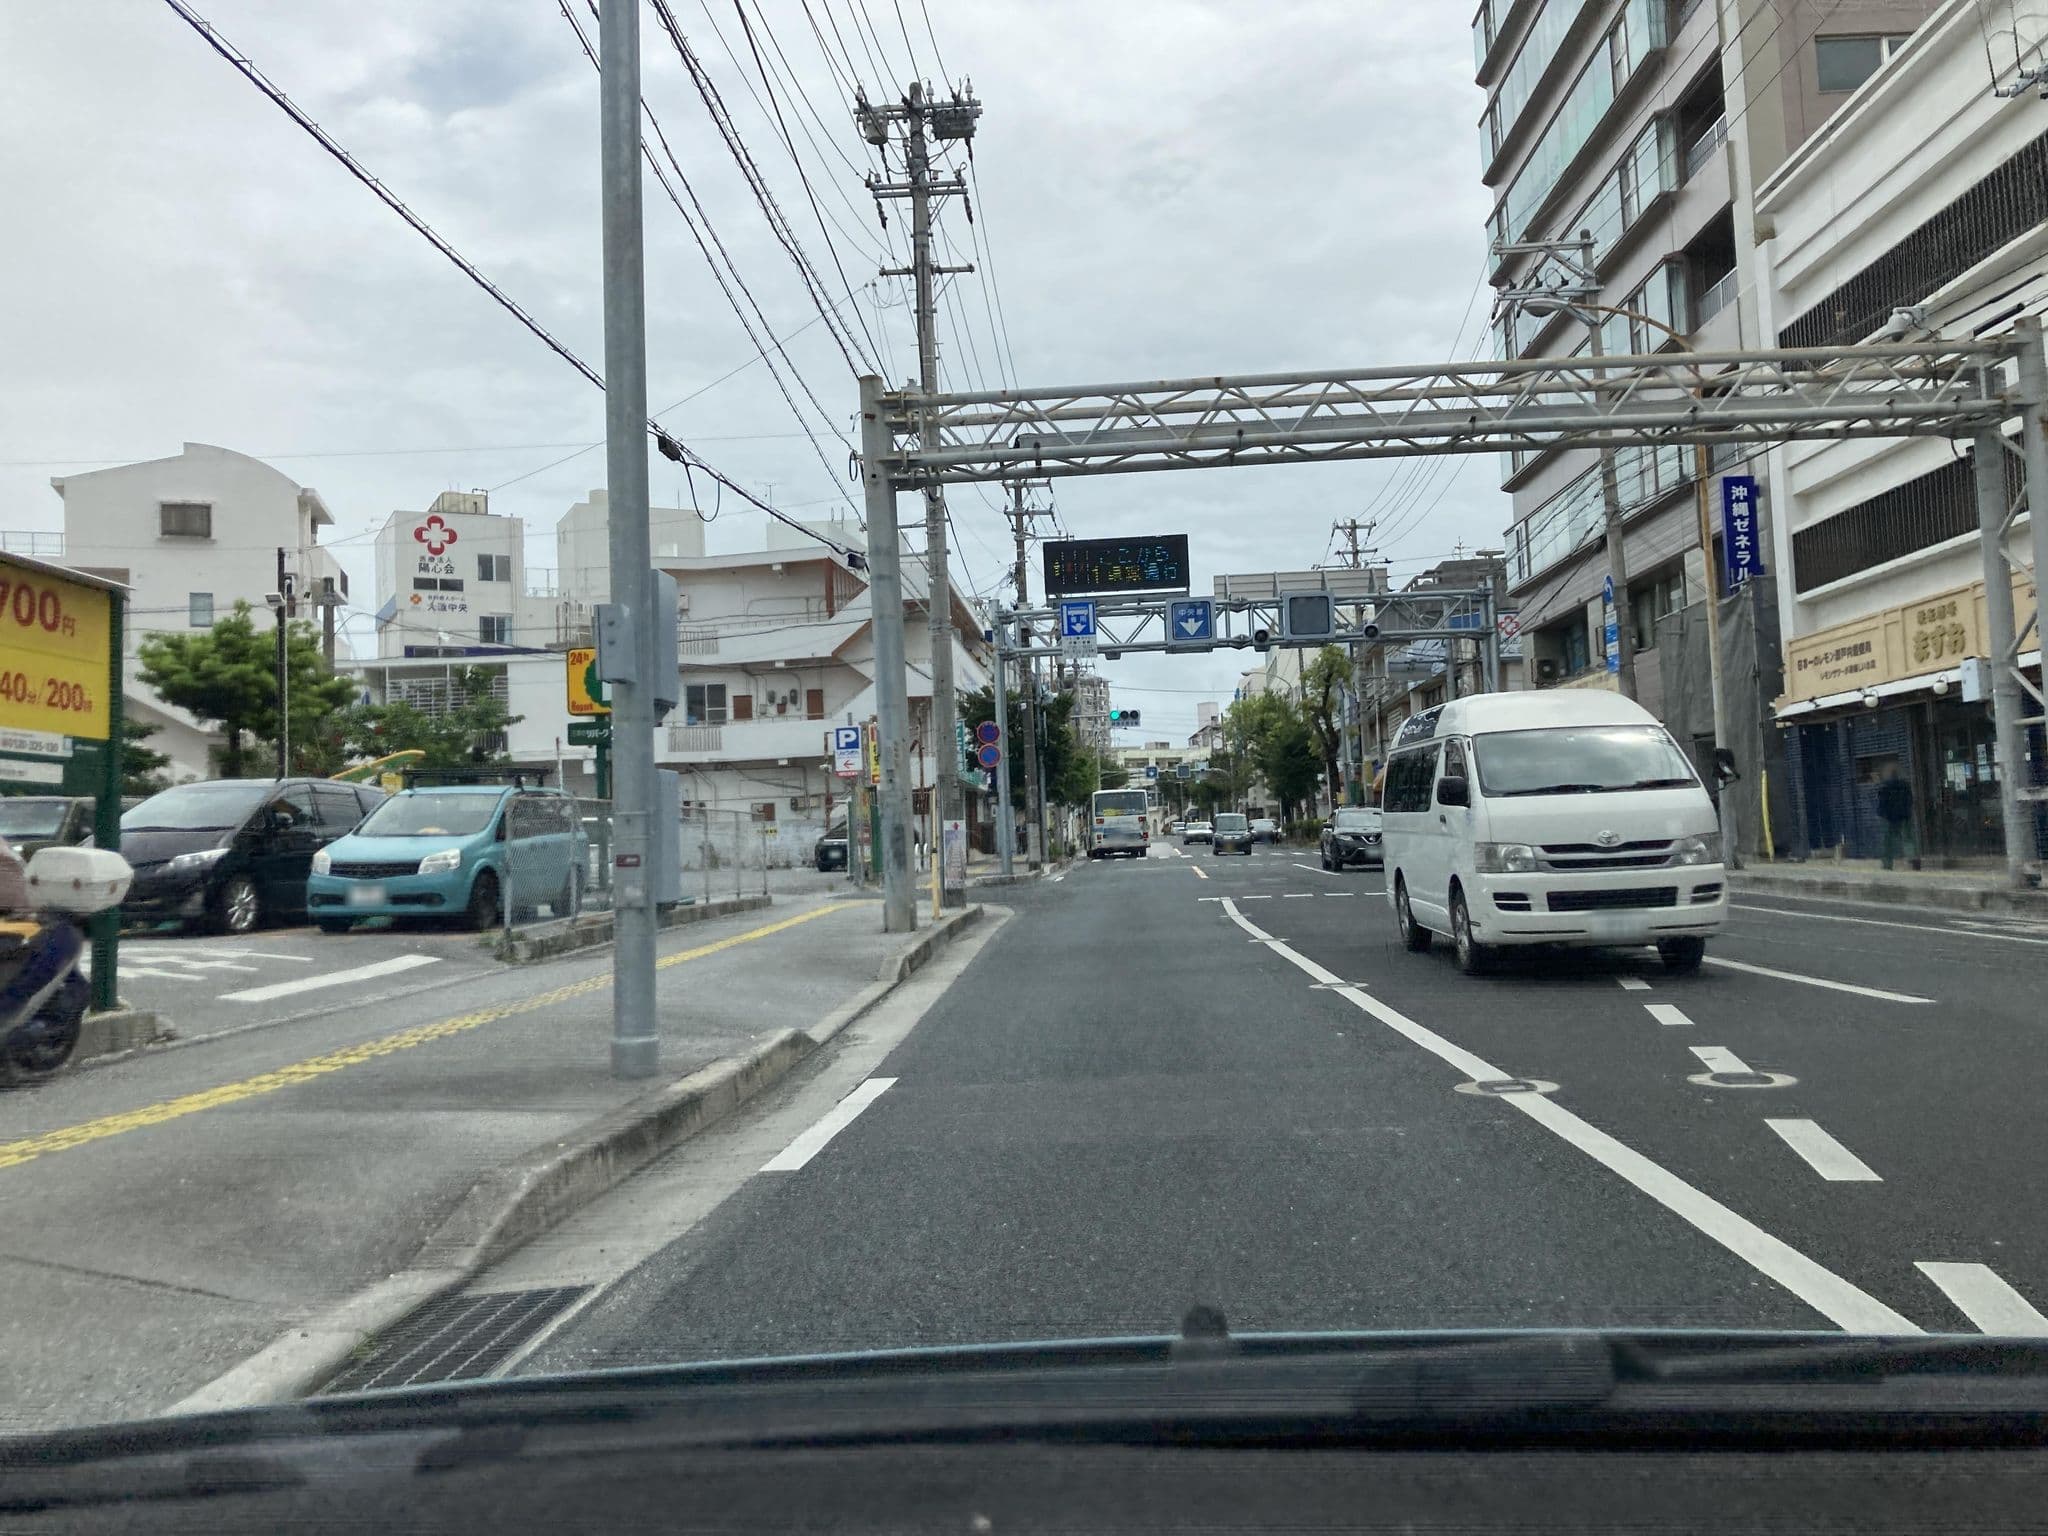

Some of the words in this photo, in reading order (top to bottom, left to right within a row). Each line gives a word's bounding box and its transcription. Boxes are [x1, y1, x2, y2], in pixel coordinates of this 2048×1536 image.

[418, 562, 455, 575] 陽心会
[570, 652, 590, 666] 24h
[839, 729, 857, 748] P
